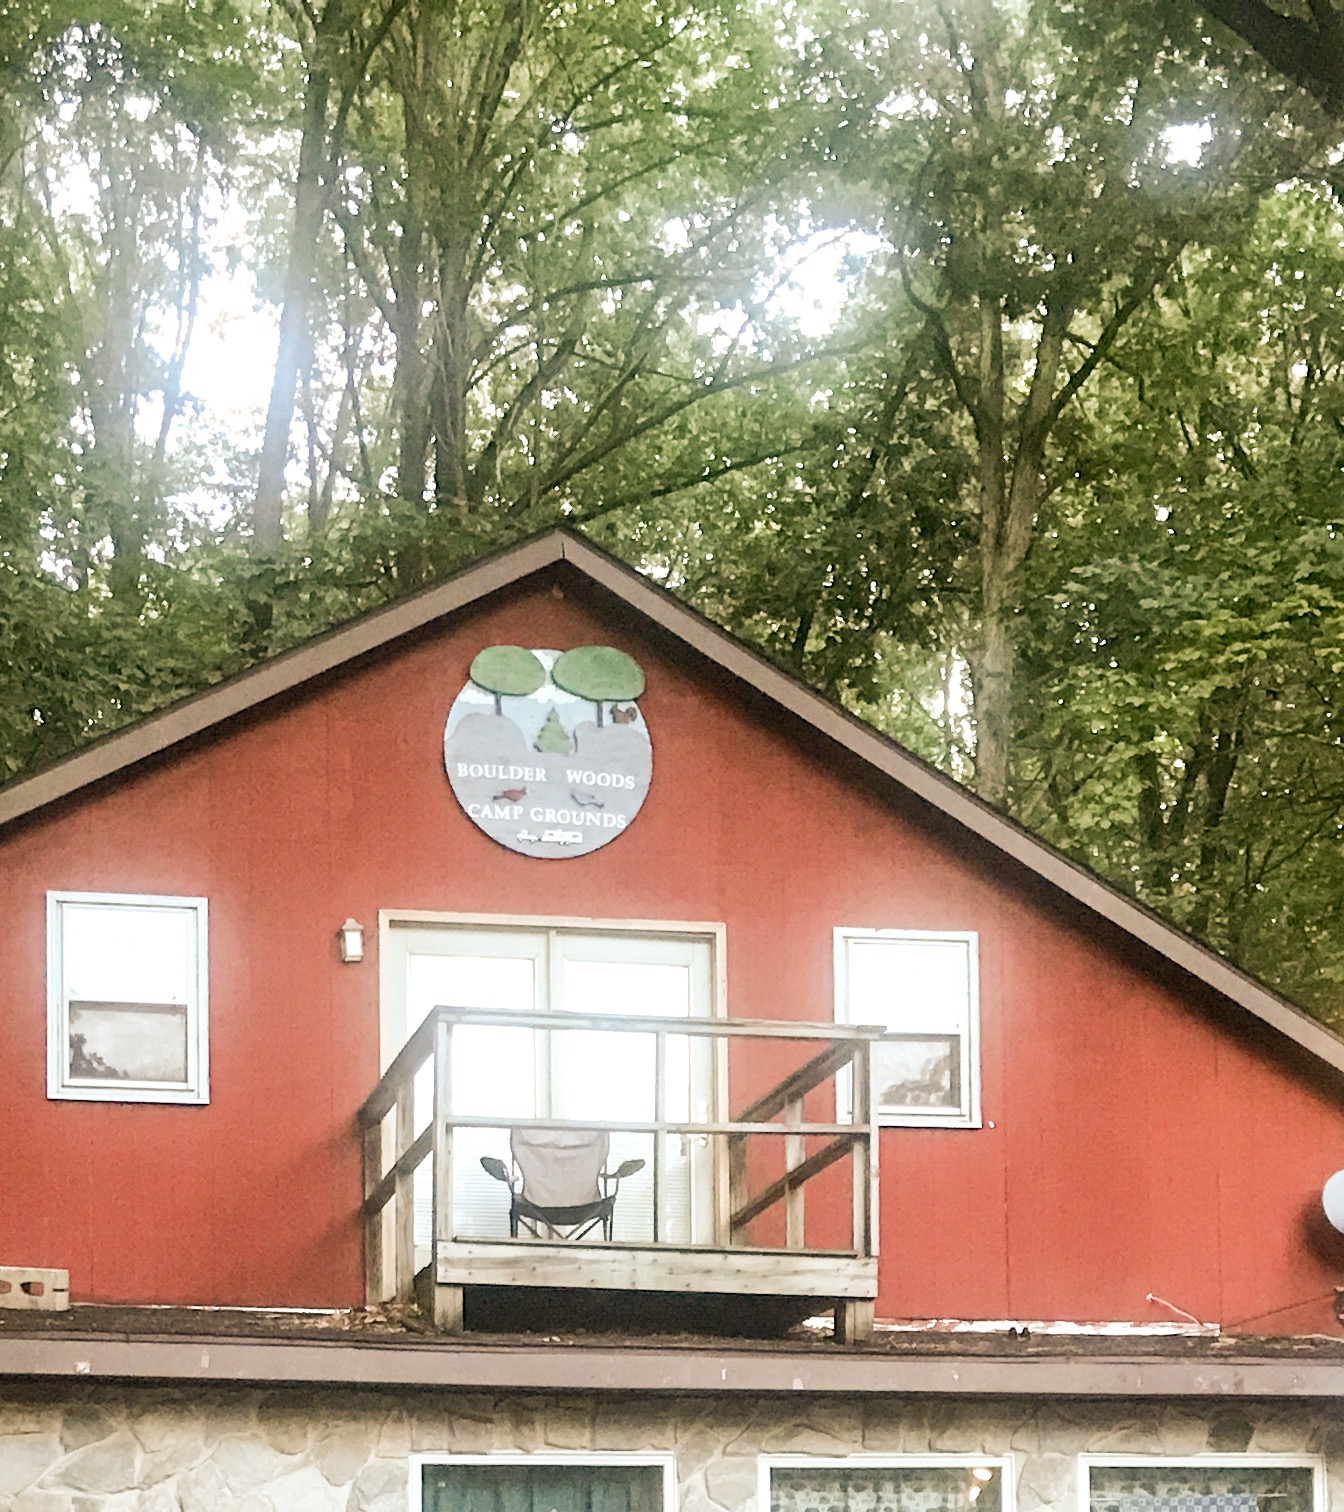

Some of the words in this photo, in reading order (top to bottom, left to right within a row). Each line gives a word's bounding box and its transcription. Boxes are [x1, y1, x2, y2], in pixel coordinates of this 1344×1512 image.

[457, 762, 547, 783] BOULDER
[566, 769, 635, 790] WOODS
[467, 803, 524, 821] CAMP
[529, 806, 628, 829] GROUNDS
